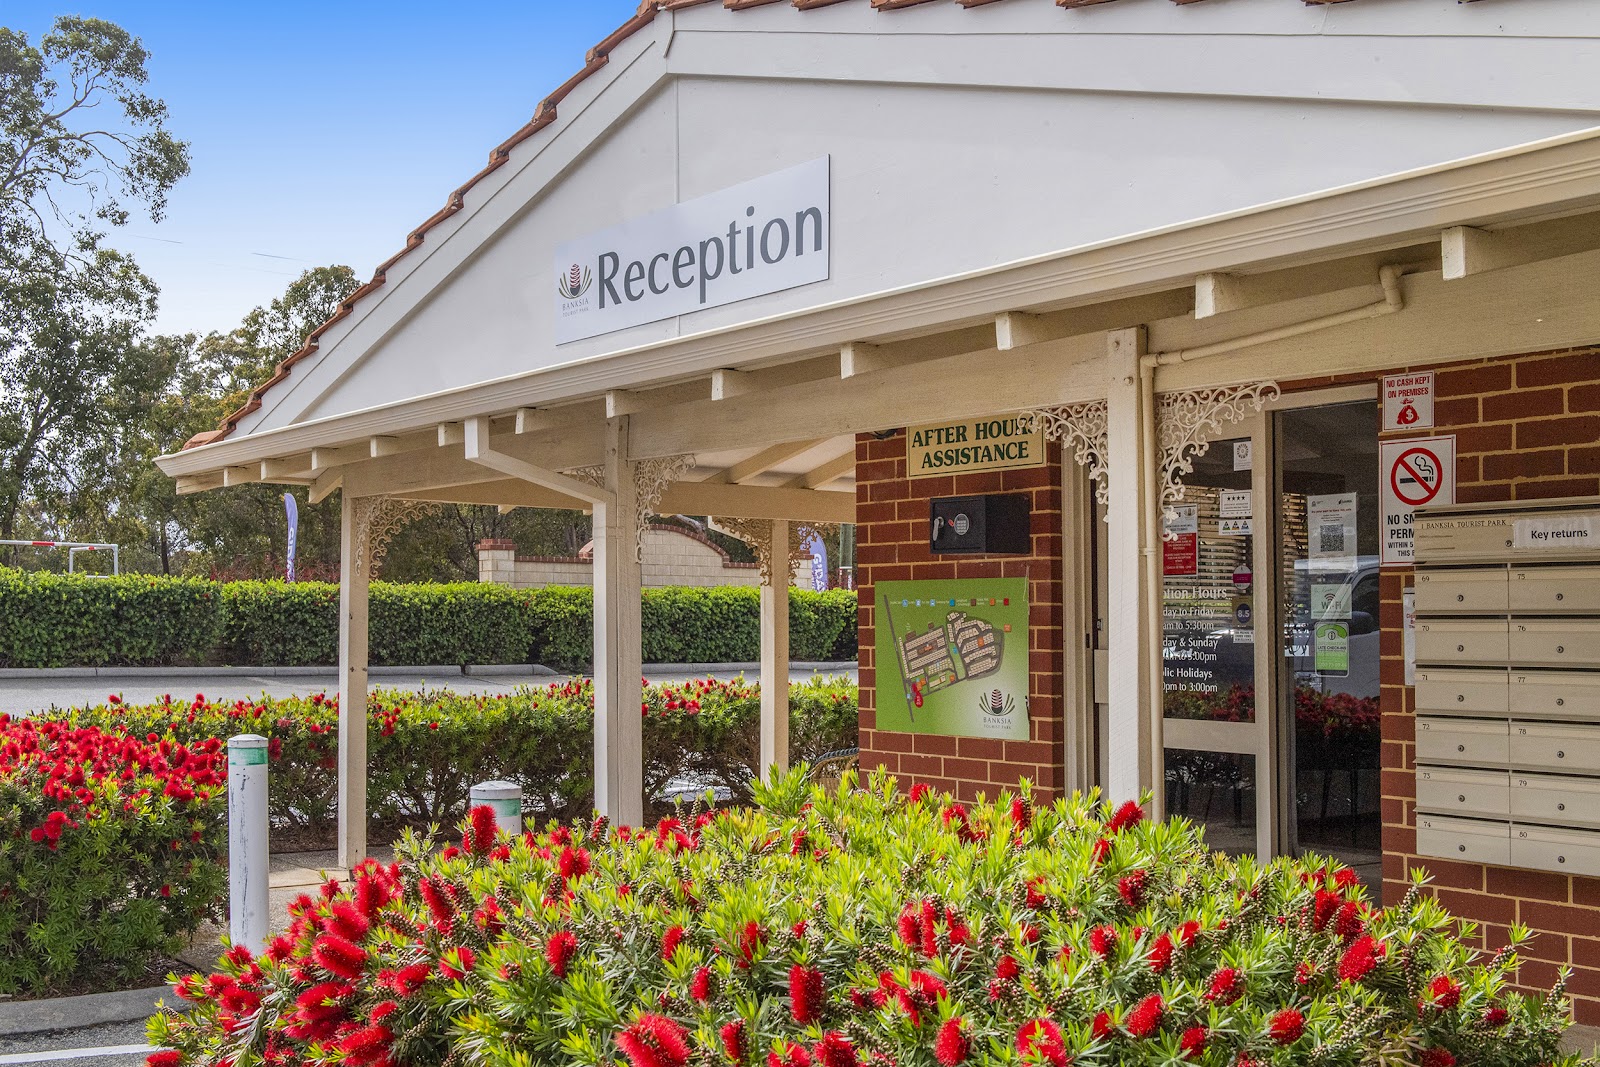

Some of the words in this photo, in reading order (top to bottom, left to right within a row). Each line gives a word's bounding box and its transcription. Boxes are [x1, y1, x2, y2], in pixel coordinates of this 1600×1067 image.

[598, 206, 822, 309] Reception
[562, 297, 589, 311] BANKSIA
[1386, 379, 1396, 389] NO
[1397, 377, 1414, 387] CASH
[1415, 375, 1431, 385] KEPT
[1388, 389, 1397, 399] ON
[1398, 387, 1429, 398] PREMISES
[911, 425, 967, 448] AFTER
[921, 441, 1029, 469] ASSISTANCE
[1387, 514, 1400, 525] NO
[1531, 530, 1549, 540] Key
[1551, 529, 1588, 539] returns
[1387, 541, 1408, 549] WITHIN
[1397, 549, 1411, 557] THIS
[1192, 585, 1227, 600] Hours
[1179, 608, 1187, 616] to
[1190, 606, 1215, 618] Friday
[1237, 609, 1250, 618] 8.5
[1176, 620, 1183, 630] to
[1185, 620, 1214, 633] 5:30pm
[1179, 637, 1186, 647] &
[1188, 637, 1218, 649] Sunday
[1163, 666, 1175, 677] lic
[1176, 667, 1213, 680] Holidays
[1179, 683, 1187, 691] to
[1189, 682, 1218, 695] 3:00pm
[983, 716, 1012, 725] BANKSIA
